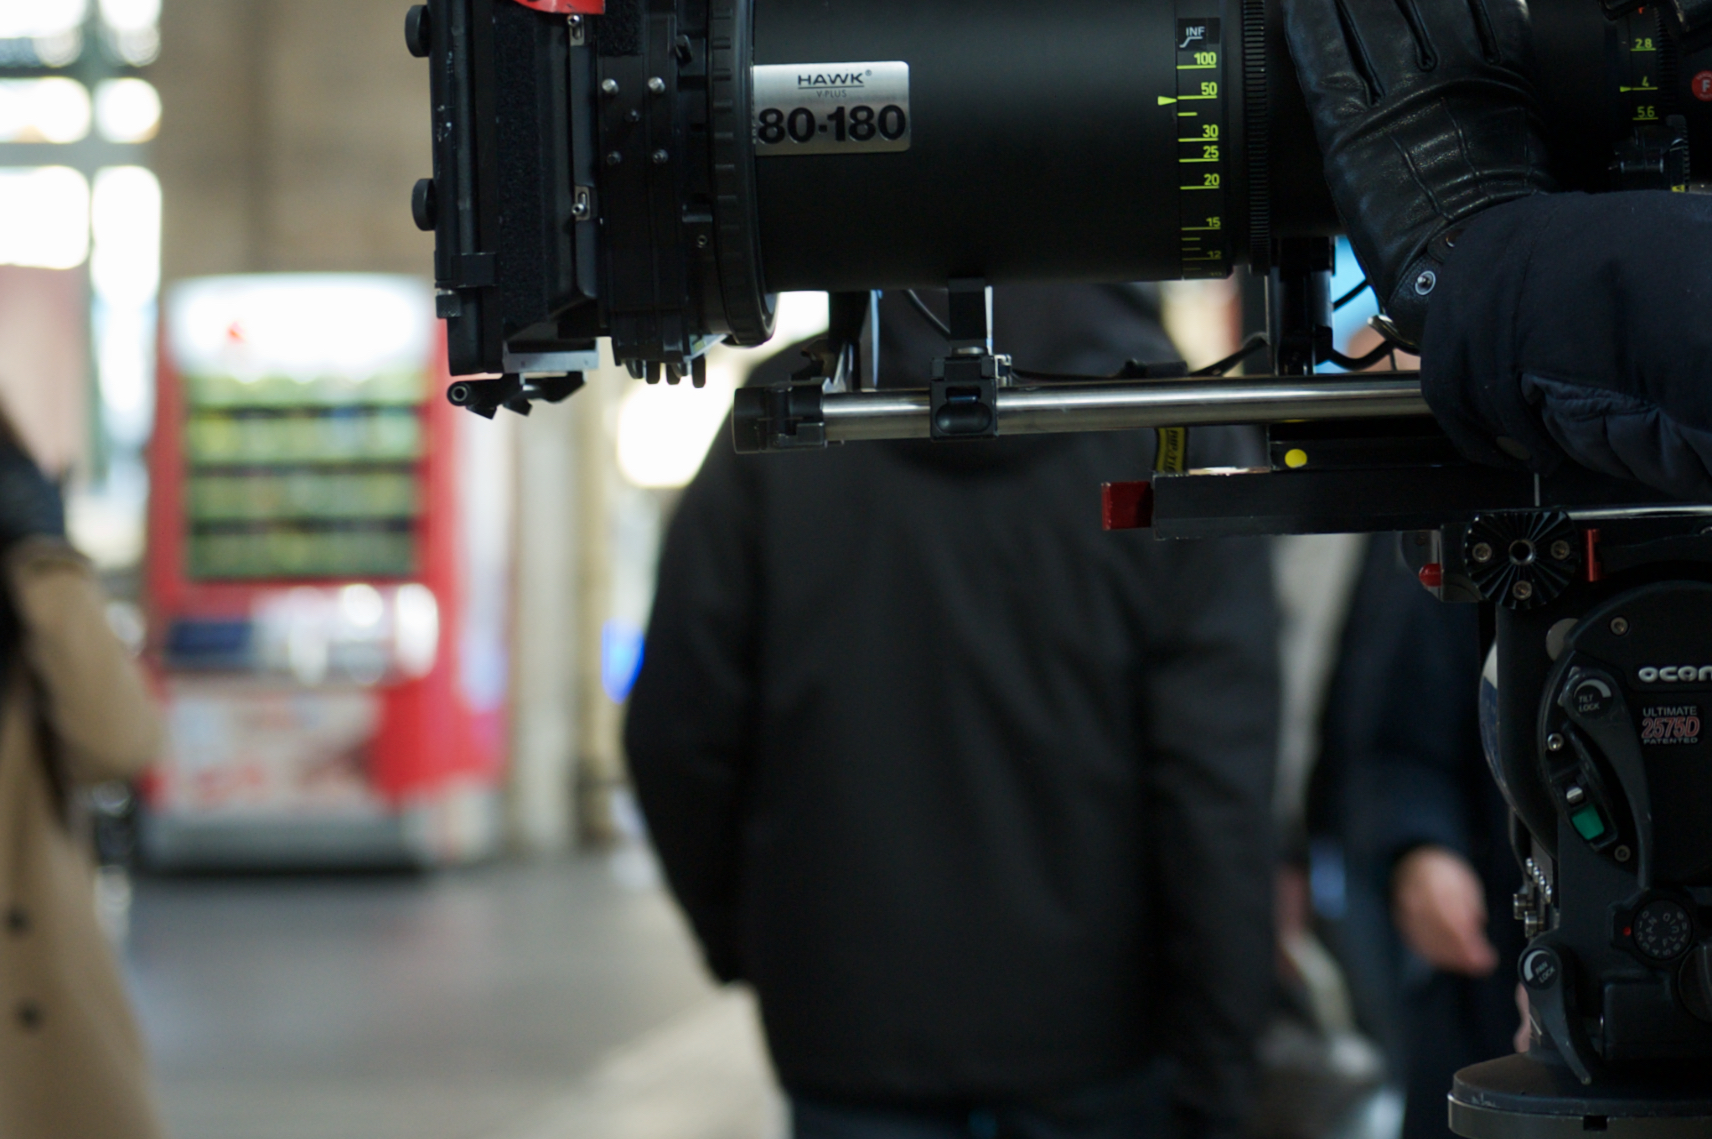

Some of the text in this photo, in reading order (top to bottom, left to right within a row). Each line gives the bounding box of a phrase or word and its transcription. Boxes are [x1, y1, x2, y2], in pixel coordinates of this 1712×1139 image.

[1186, 26, 1206, 37] INF
[1194, 51, 1217, 65] 100
[1201, 81, 1218, 95] 50
[1641, 76, 1650, 87] 4
[1702, 79, 1711, 93] F
[758, 104, 906, 144] 80-180
[1202, 124, 1219, 138] 30
[1203, 145, 1219, 158] 25
[1204, 173, 1220, 186] 20
[1206, 217, 1221, 227] 15
[1579, 694, 1593, 703] TILT
[1578, 703, 1600, 712] LOCK
[1643, 706, 1698, 717] ULTIMATE
[1641, 716, 1700, 739] 2575D
[1643, 737, 1699, 745] PATENTED
[1538, 965, 1556, 984] LOCK
